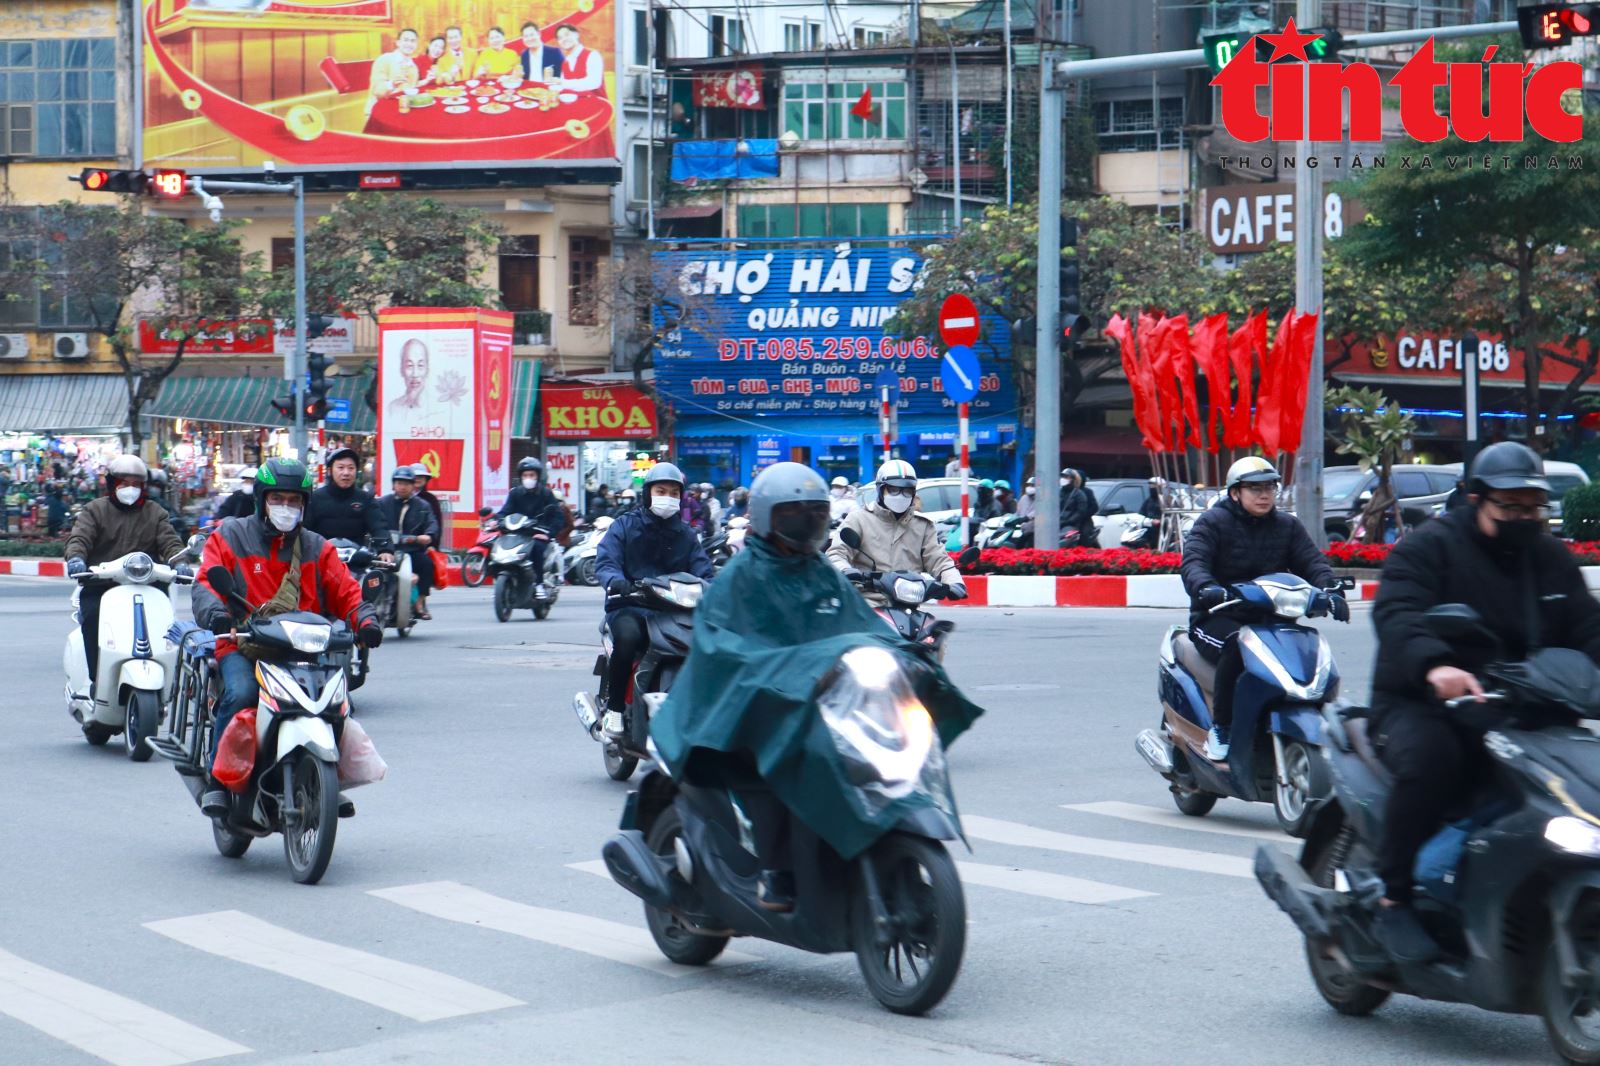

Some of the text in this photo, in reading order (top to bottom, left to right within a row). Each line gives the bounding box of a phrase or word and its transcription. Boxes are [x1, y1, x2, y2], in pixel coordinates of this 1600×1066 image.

[156, 174, 182, 195] 48
[1210, 194, 1294, 247] CAFE
[678, 252, 774, 303] CHỢ
[747, 299, 897, 331] QUẢNG NIN
[782, 363, 806, 375] Bán
[812, 362, 846, 375] Buôn
[1478, 339, 1510, 372] 88
[692, 377, 725, 394] TÔM
[739, 379, 769, 393] CUA
[783, 379, 812, 396] GHẸ
[825, 377, 861, 395] MỰC
[547, 400, 652, 429] KHÓA
[813, 400, 837, 411] Ship
[839, 400, 866, 411] hàng
